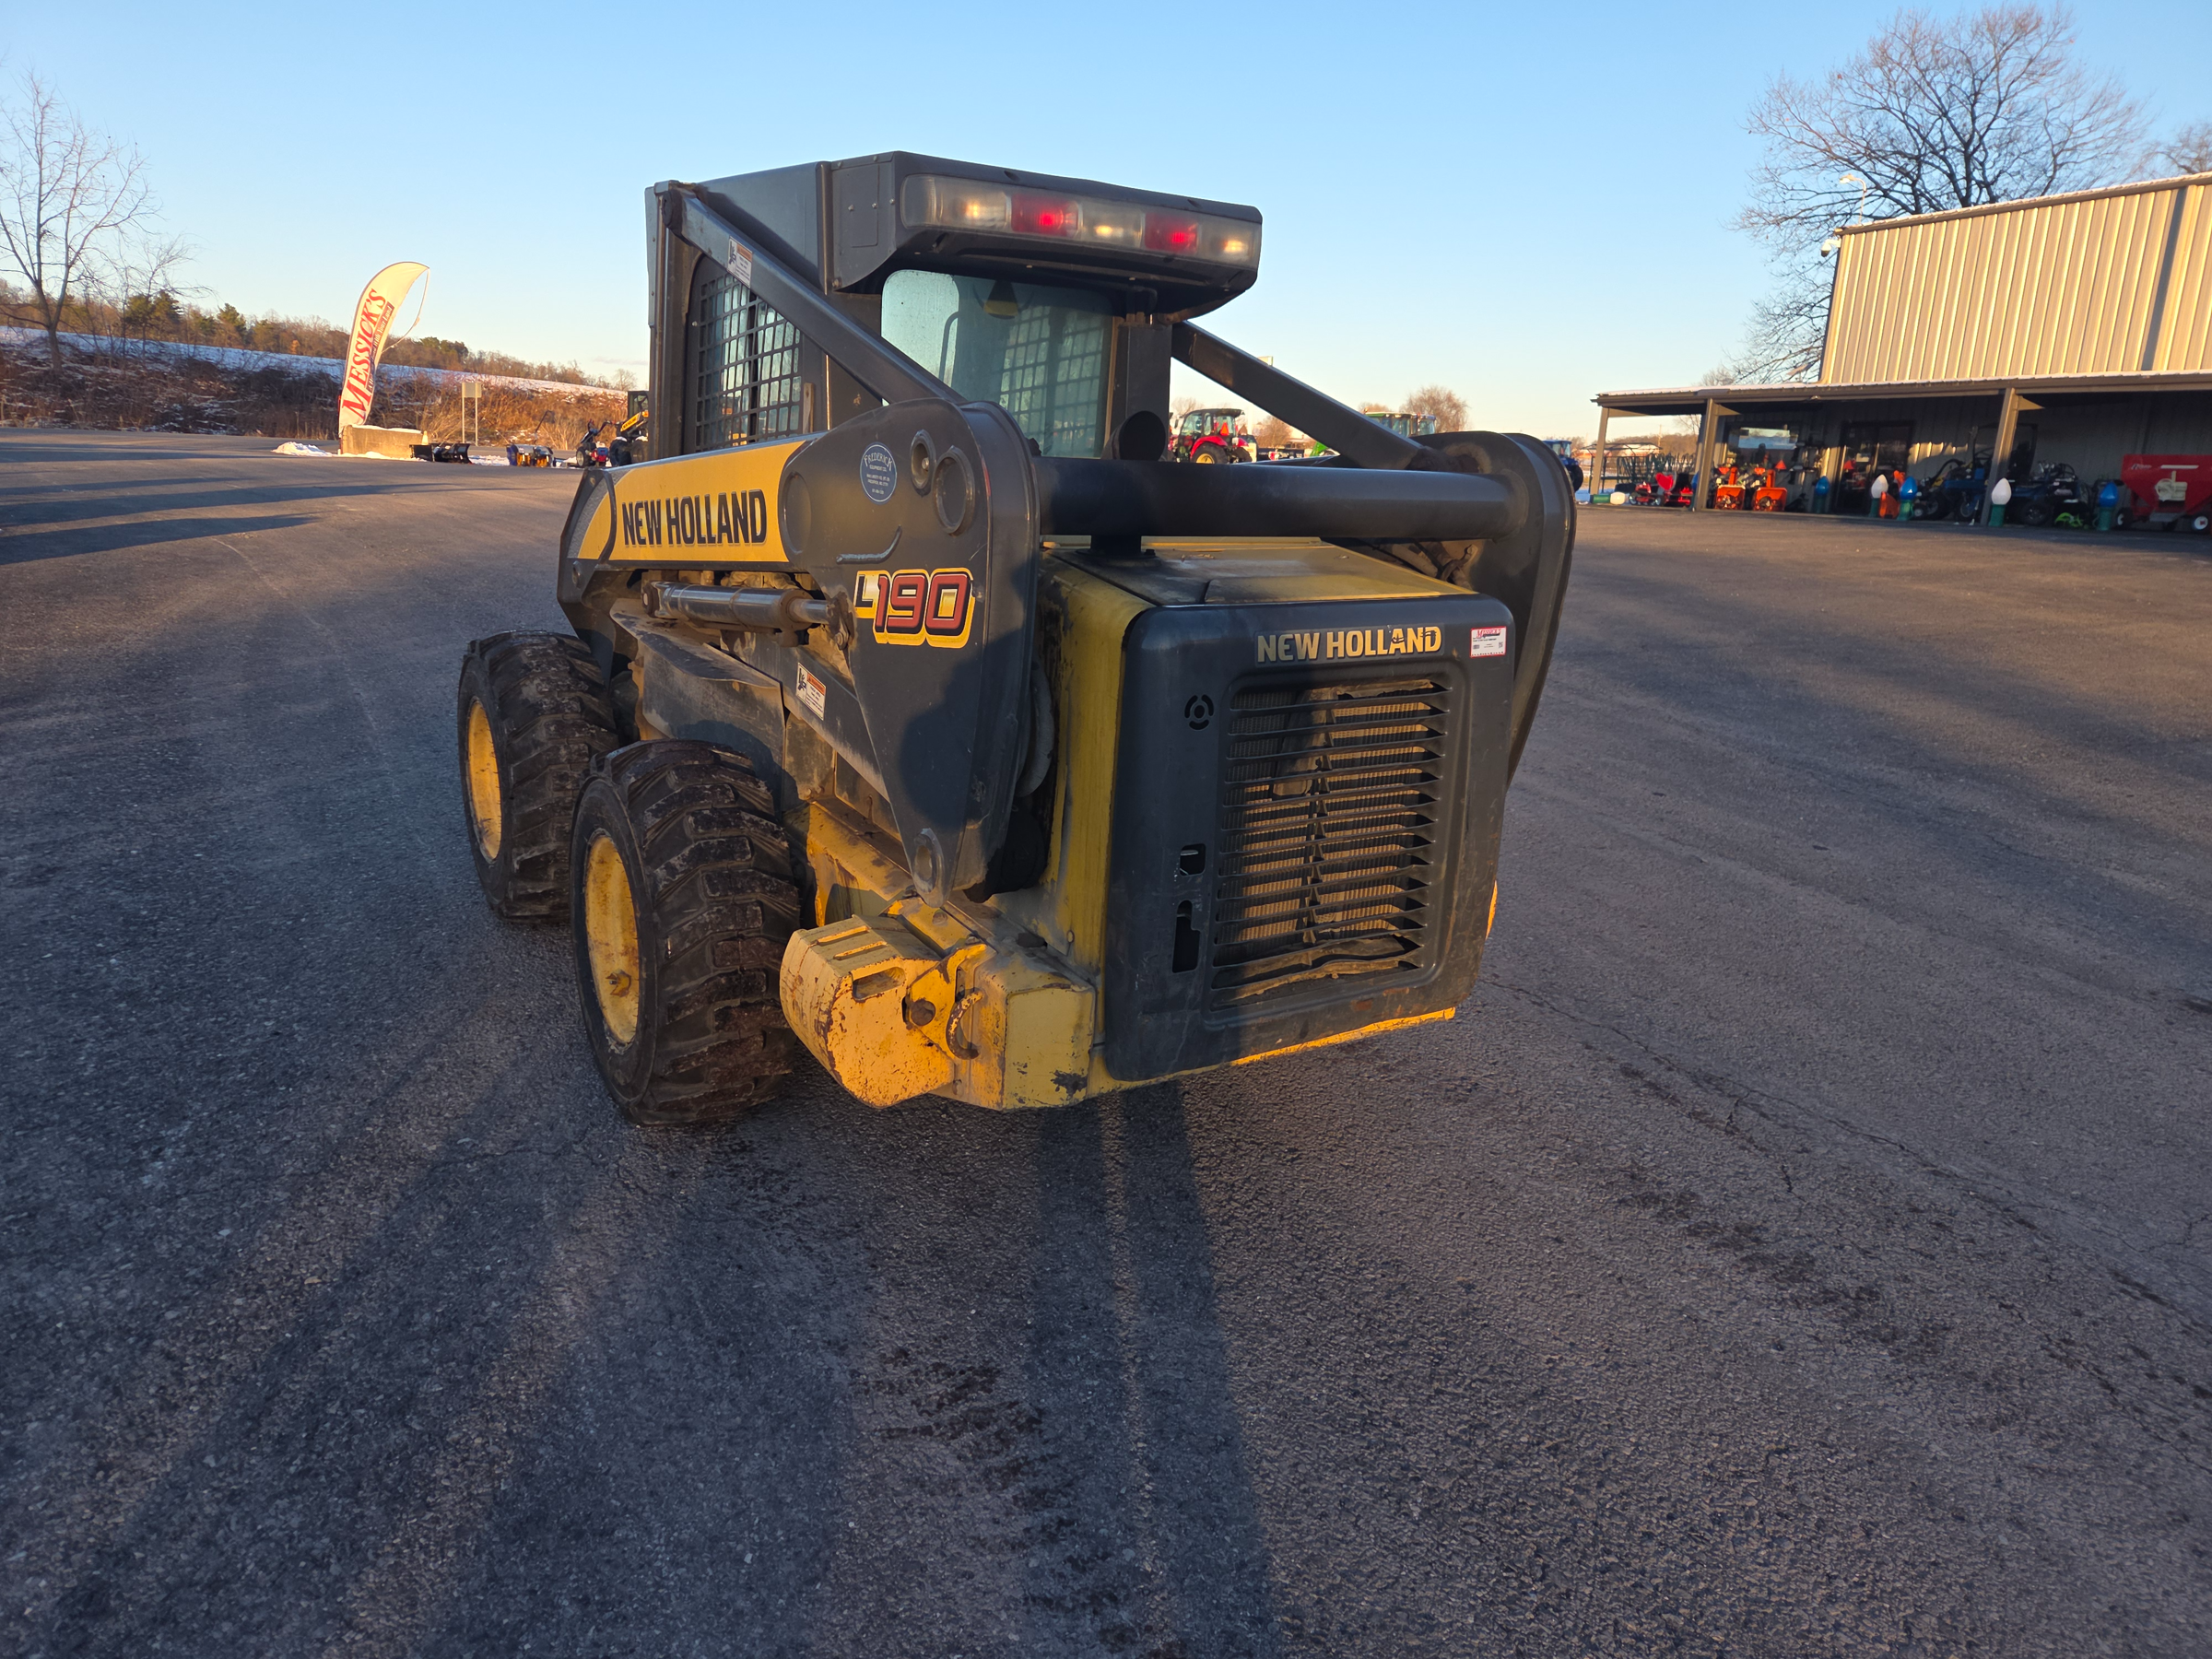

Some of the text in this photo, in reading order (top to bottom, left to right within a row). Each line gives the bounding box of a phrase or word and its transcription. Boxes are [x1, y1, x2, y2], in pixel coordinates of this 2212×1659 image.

[377, 321, 386, 334] Your
[382, 305, 393, 322] Land
[342, 288, 386, 419] MESSICK'S
[622, 488, 768, 547] NEW HOLLAND
[853, 569, 975, 647] L190
[1257, 626, 1441, 663] NEW HOLLAND
